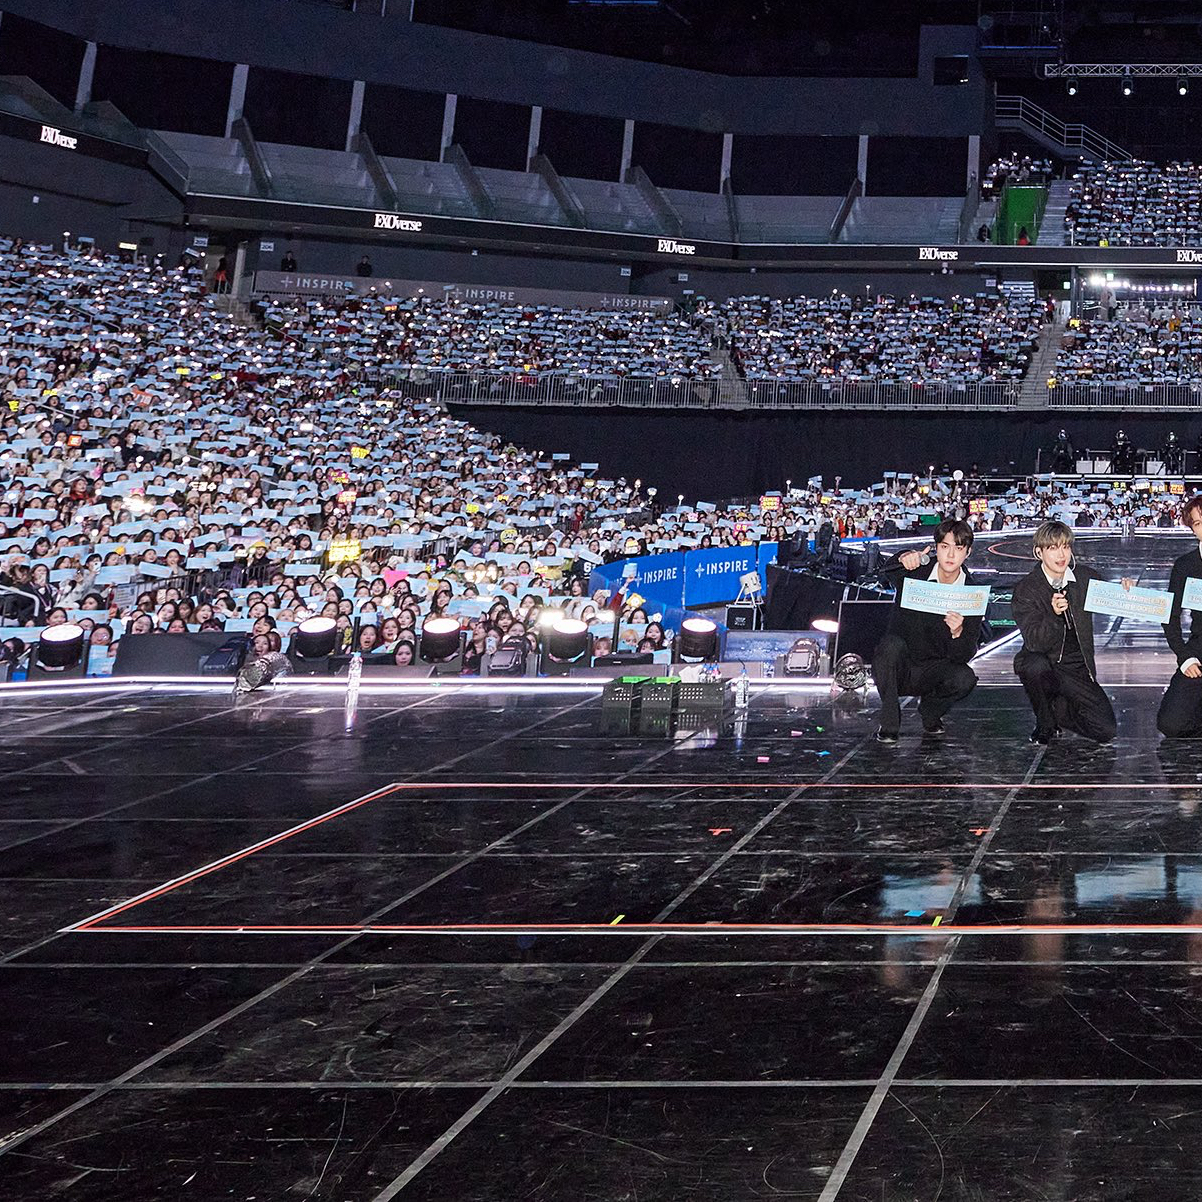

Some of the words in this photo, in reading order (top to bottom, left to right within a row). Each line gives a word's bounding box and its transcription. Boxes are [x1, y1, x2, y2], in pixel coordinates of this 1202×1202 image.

[297, 278, 344, 290] INSPIR
[466, 289, 514, 301] INSPIRE
[707, 560, 749, 576] INSPIRE
[644, 567, 677, 584] INSPIRE
